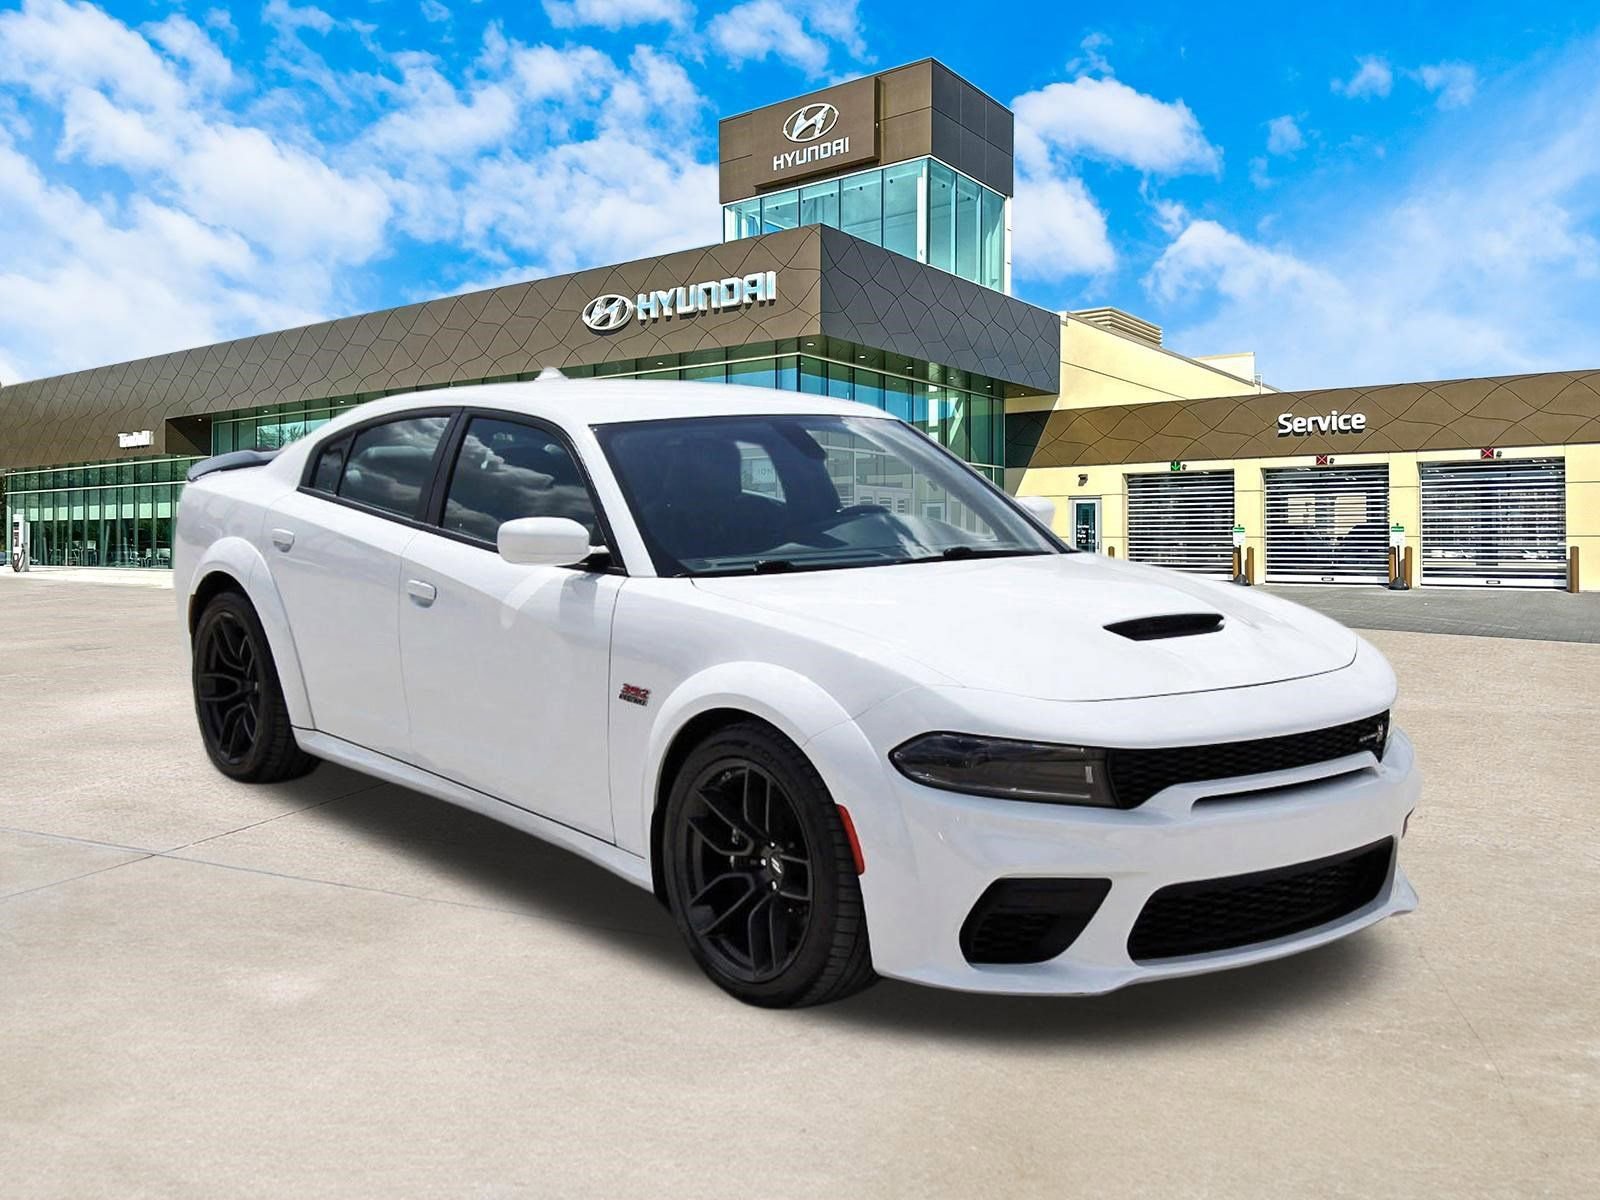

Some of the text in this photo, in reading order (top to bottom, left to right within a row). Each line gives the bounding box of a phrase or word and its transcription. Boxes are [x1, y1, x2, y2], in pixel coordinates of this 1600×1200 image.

[773, 137, 849, 171] HYUNDAI
[637, 271, 776, 321] HYUNDAI
[1278, 410, 1366, 434] Service
